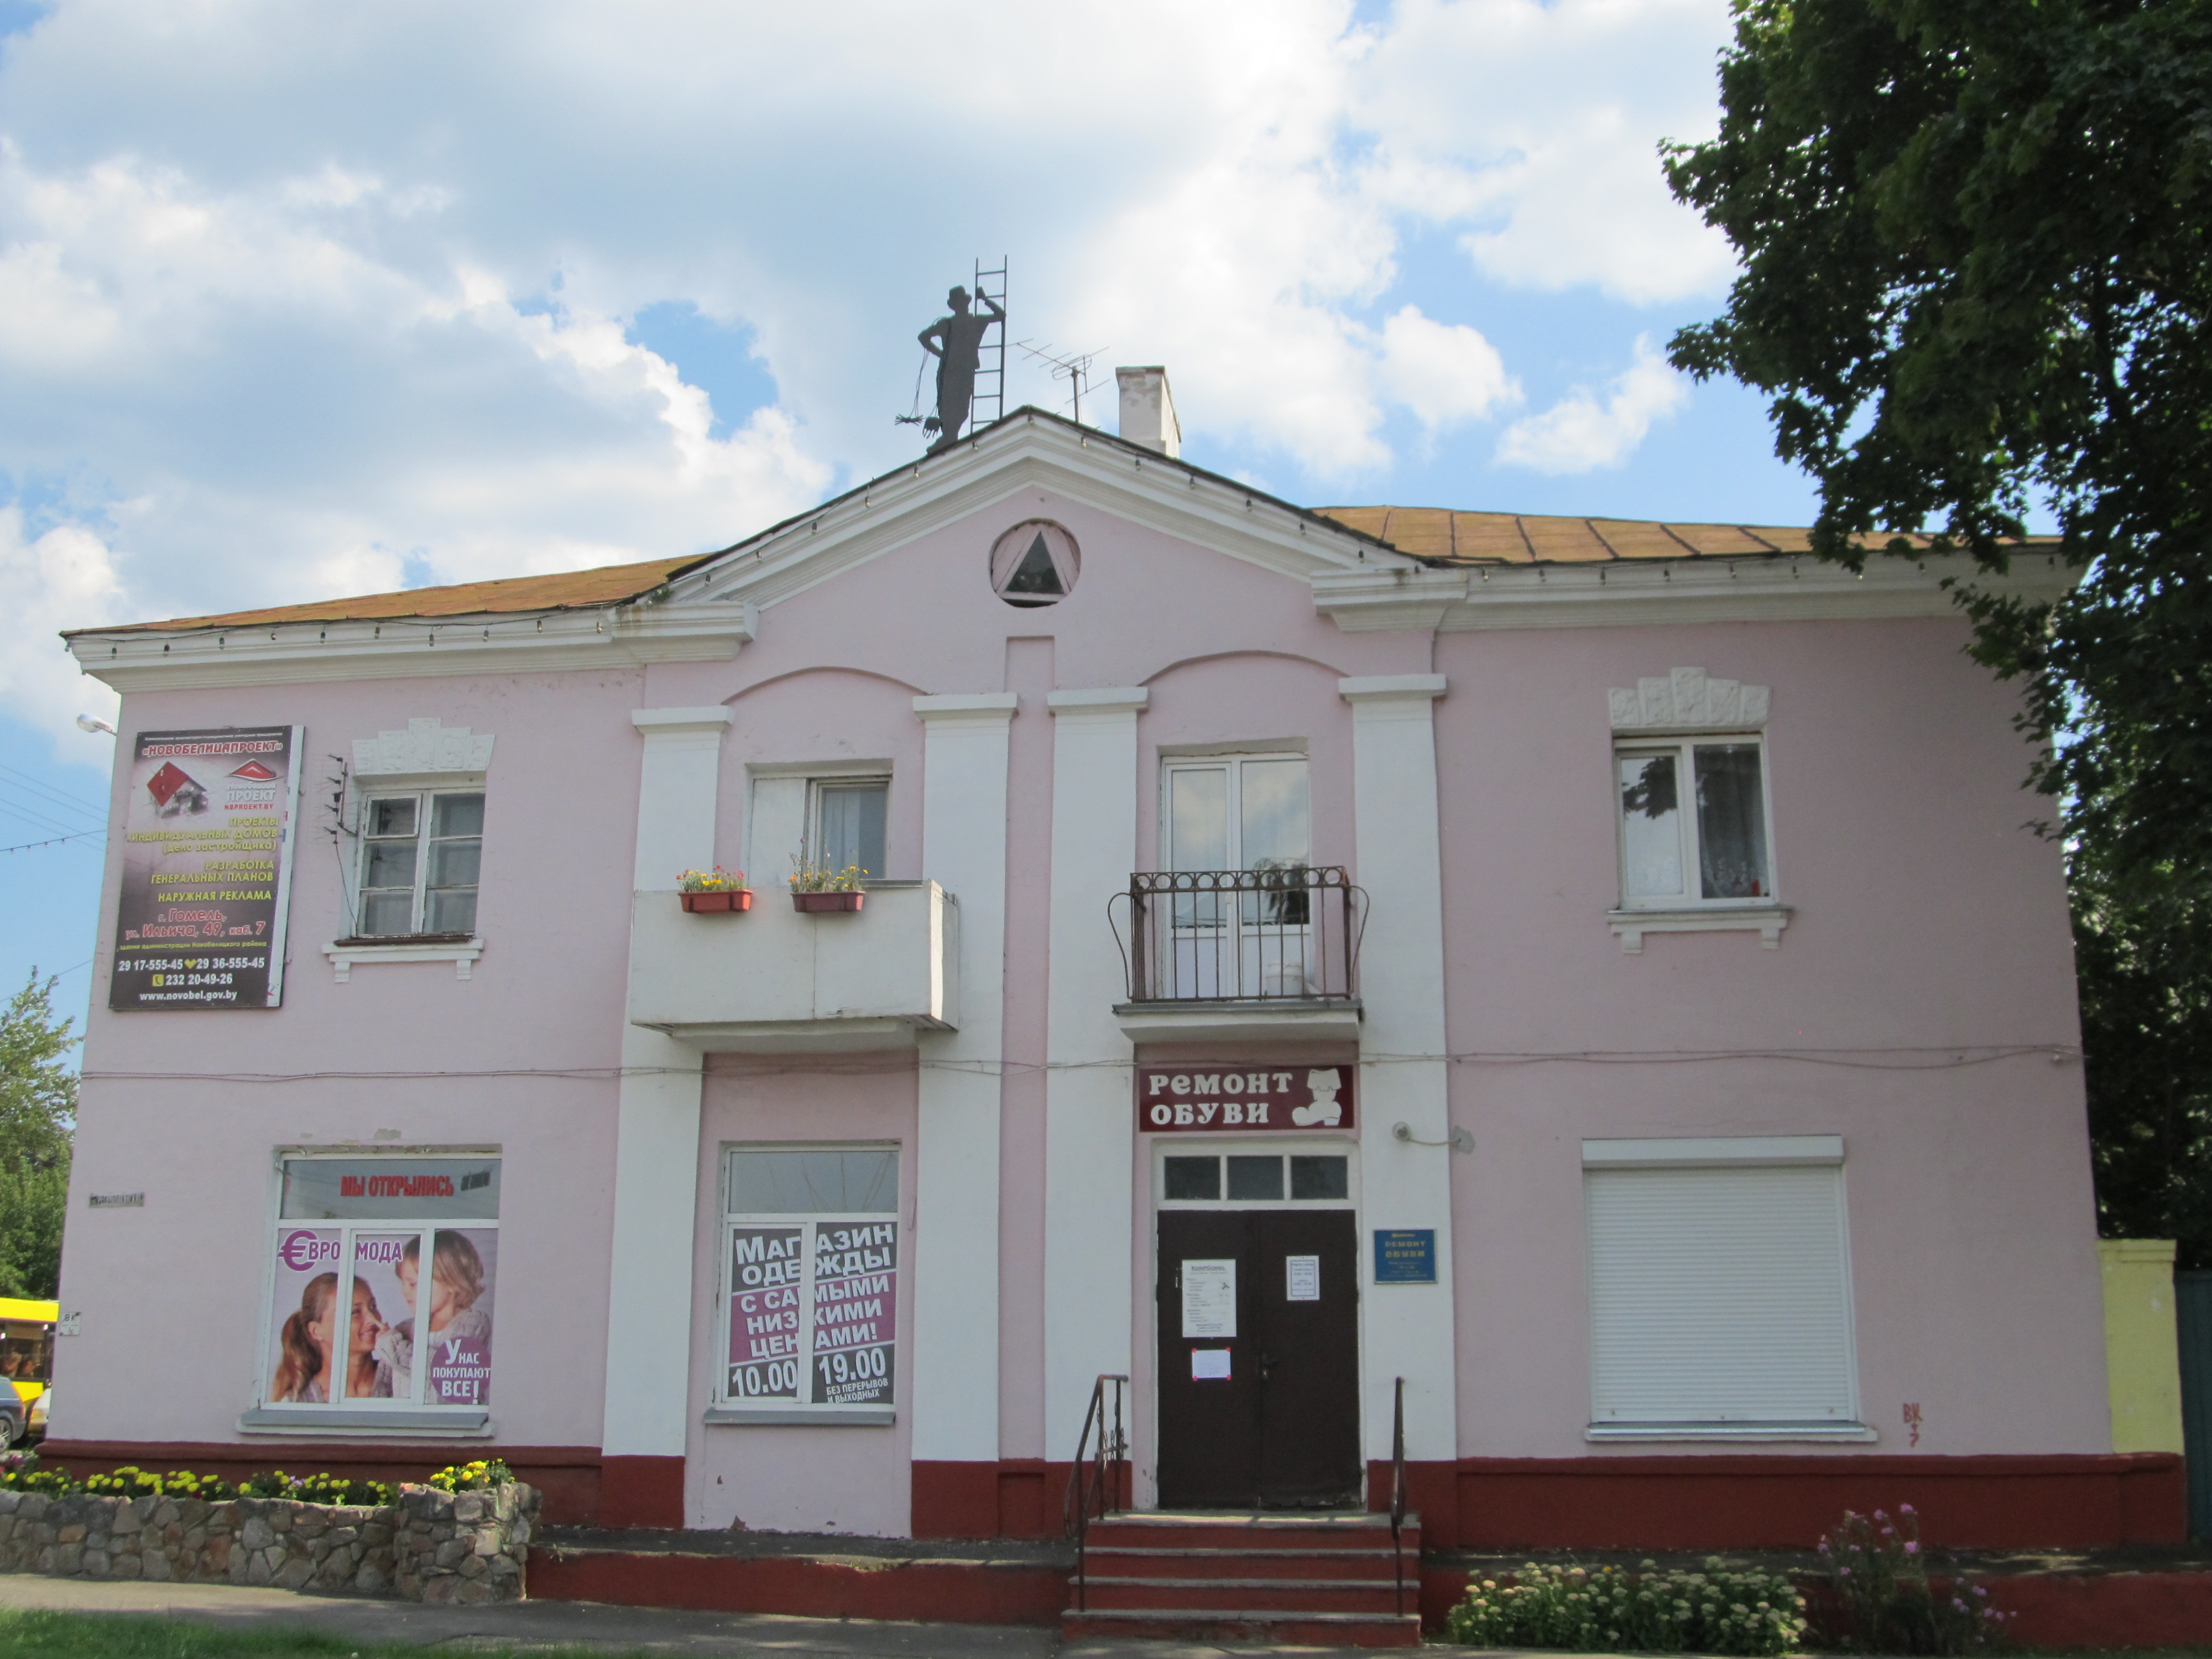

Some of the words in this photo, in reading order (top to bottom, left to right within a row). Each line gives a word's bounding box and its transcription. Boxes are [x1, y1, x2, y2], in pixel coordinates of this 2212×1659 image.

[142, 740, 283, 757] «НОВОБЕЛИЦАПРОЕКТ»
[227, 790, 276, 802] ПРОЕКТ
[229, 817, 279, 827] ПРОЕКТЫ
[131, 830, 231, 842] ИНДИВИДУАЛЬНЫХ
[234, 828, 278, 839] ДОМОВ
[163, 843, 194, 854] (дело
[196, 842, 277, 853] застройщика)
[205, 860, 274, 871] РАЗРАБОТКА
[151, 873, 223, 884] ГЕНЕРАЛЬНЫХ
[227, 872, 274, 882] ПЛАНОВ
[158, 891, 216, 902] НАРУЖНАЯ
[220, 890, 272, 900] РЕКЛАМА
[169, 908, 227, 922] Гомель,
[142, 925, 200, 938] Ильича,
[202, 922, 226, 937] 49,
[229, 925, 253, 936] каб.
[255, 921, 266, 935] 7
[118, 960, 131, 971] 29
[134, 958, 184, 971] 17-555-45
[196, 958, 210, 969] 29
[212, 957, 265, 969] 36-555-45
[166, 974, 185, 985] 232
[187, 973, 233, 985] 20-49-26
[139, 990, 238, 1001] www.novobel.gov.by
[1149, 1072, 1293, 1095] РЕМОНТ
[1150, 1103, 1269, 1125] ОБУВИ
[340, 1175, 365, 1197] МЫ
[368, 1175, 454, 1197] ОТКРЫЛИСЬ
[356, 1241, 403, 1264] МОДА
[735, 1223, 894, 1265] МАГАЗИН
[742, 1247, 891, 1287] ОДЕЖДЫ
[740, 1295, 757, 1313] С
[764, 1275, 890, 1310] САМЫМИ
[746, 1298, 883, 1335] НИЗКИМИ
[750, 1322, 878, 1360] ЦЕНАМИ!
[432, 1367, 491, 1379] ПОКУПАЮТ
[818, 1347, 886, 1385] 19.00
[732, 1360, 797, 1397] 10.00
[826, 1385, 842, 1396] БЕЗ
[842, 1378, 888, 1394] ПЕРЕРЫВОВ
[442, 1380, 480, 1405] ВСЕ!
[834, 1389, 880, 1404] ВЫХОДНЫХ
